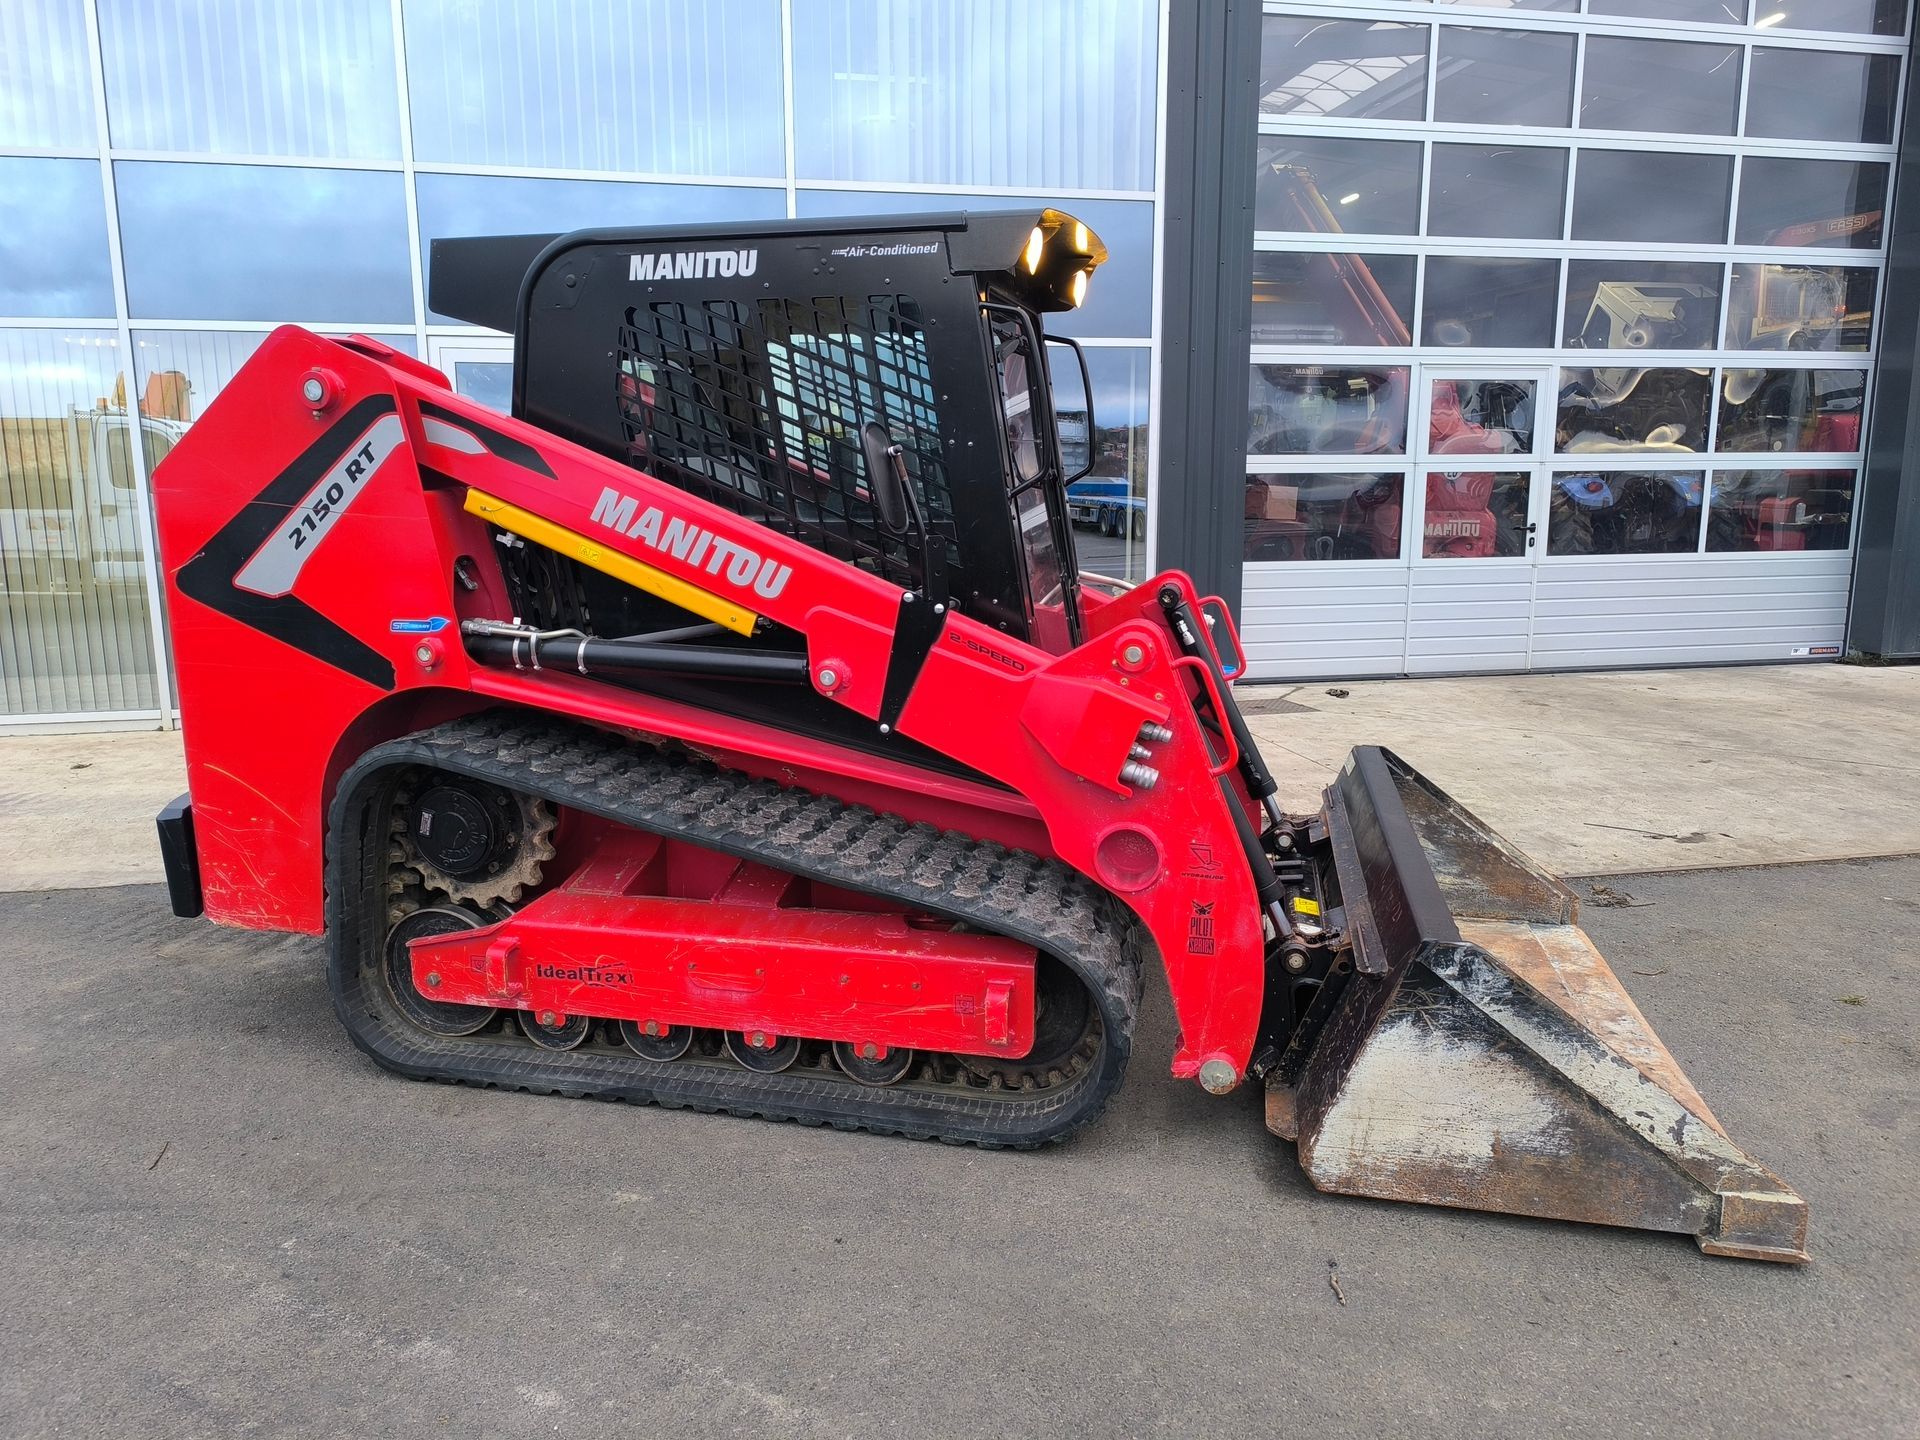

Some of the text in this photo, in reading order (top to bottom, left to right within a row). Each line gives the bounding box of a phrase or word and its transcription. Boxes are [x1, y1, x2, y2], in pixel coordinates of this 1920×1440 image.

[1829, 216, 1866, 231] FASSI
[847, 242, 939, 257] Air-Conditioned
[629, 249, 758, 281] MANITOU
[288, 440, 375, 551] 2150 RT
[1424, 519, 1481, 537] MANITOU
[589, 485, 794, 599] MANITOU
[949, 632, 1025, 672] 2-SPEED
[1190, 916, 1215, 937] PILOT
[536, 962, 628, 986] IdealTrax
